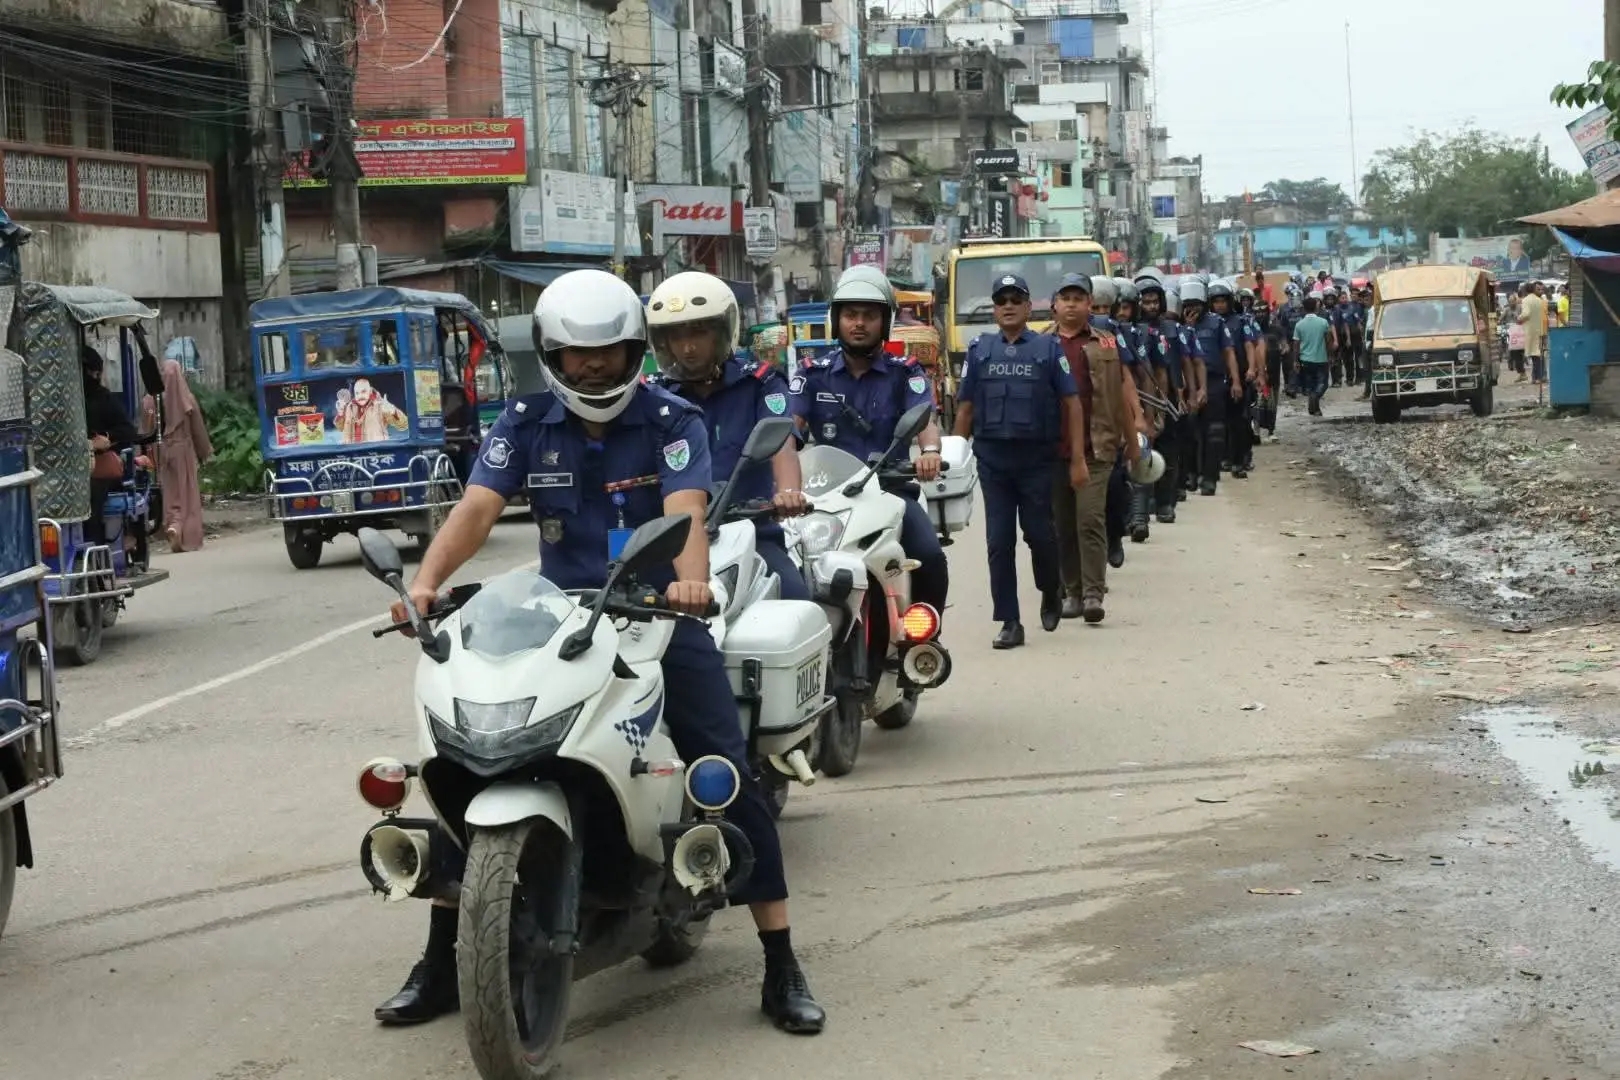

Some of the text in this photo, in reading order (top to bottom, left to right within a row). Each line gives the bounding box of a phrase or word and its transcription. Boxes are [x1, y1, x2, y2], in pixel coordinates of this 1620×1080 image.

[390, 121, 512, 136] এন্টারপ্রাইজ
[984, 157, 1015, 165] LOTTO
[988, 363, 1033, 376] POLICE
[287, 460, 315, 473] মক্কা
[352, 451, 396, 470] বাইক
[796, 659, 822, 705] POLICE
